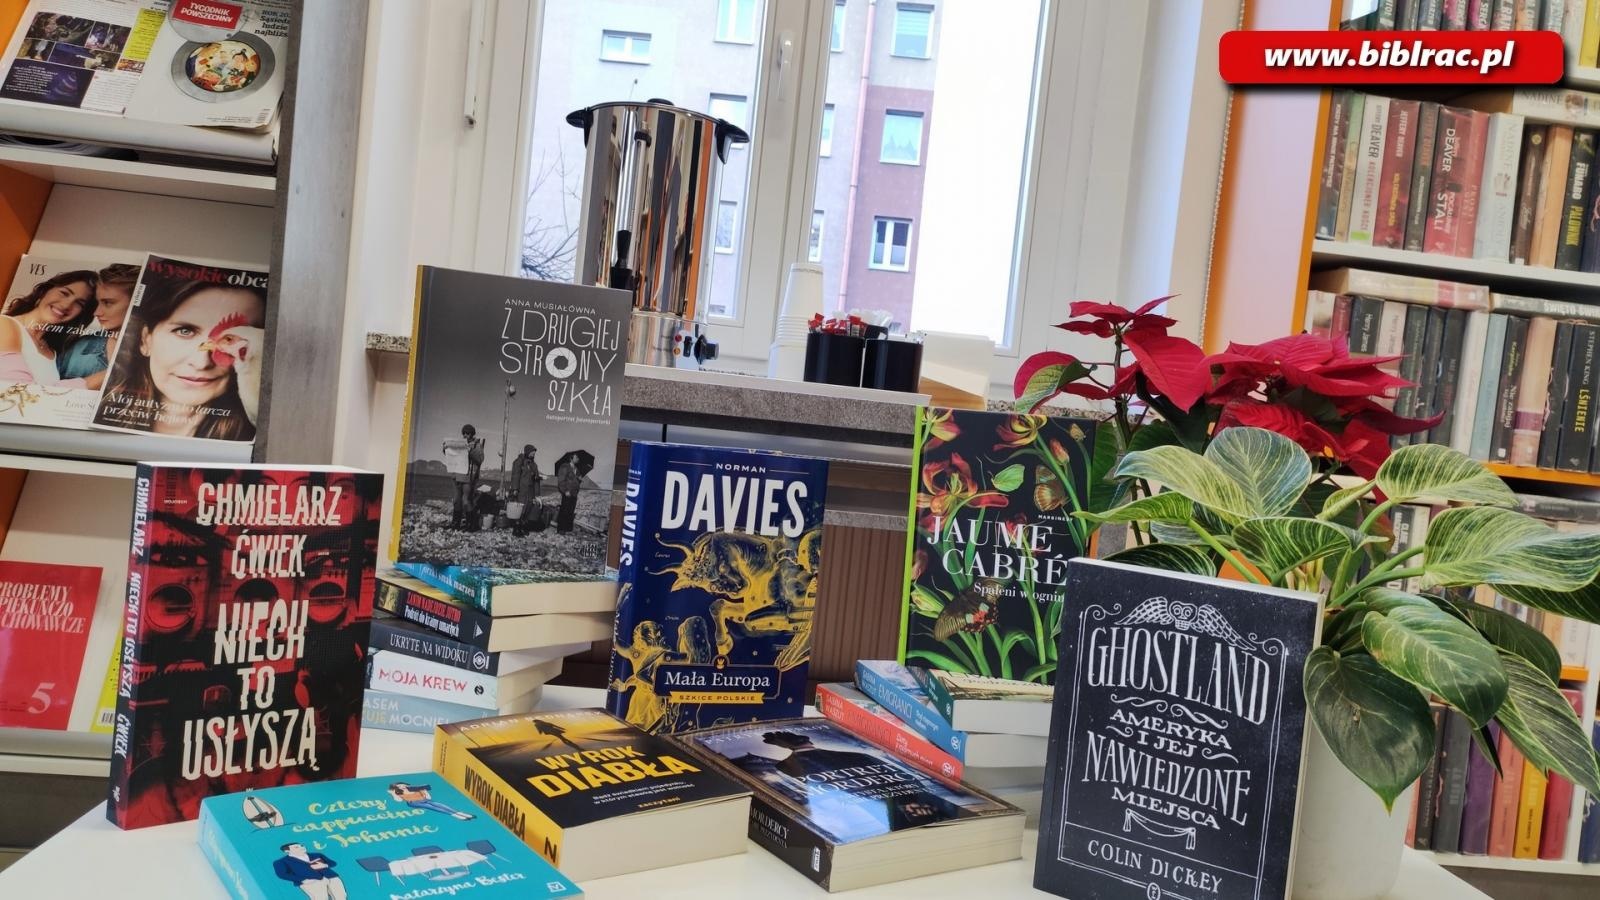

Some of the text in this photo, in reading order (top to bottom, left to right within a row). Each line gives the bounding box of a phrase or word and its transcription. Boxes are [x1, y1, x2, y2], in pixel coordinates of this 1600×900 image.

[180, 7, 234, 23] POWSZECHNY
[190, 2, 231, 15] TYGODNIK
[1367, 124, 1383, 159] DEAVER
[1441, 128, 1456, 172] DEAVER
[28, 263, 48, 276] YES
[148, 261, 227, 283] wysokie
[504, 298, 596, 315] ANNA MUSIAŁÓWNA
[501, 307, 621, 351] Z DRUGIEJ
[499, 341, 617, 383] STRONY
[1582, 330, 1596, 385] STEPHEN KING
[193, 405, 232, 417] tarcza
[547, 380, 611, 417] SZKŁA
[1574, 388, 1591, 433] LŚNIENIE
[715, 462, 767, 475] NORMAN
[130, 476, 151, 557] CHMIELARZ
[196, 482, 343, 527] CHMIELARZ
[660, 469, 809, 539] DAVIES
[620, 481, 641, 568] DAVIES
[927, 514, 1054, 553] JAUME
[230, 529, 308, 580] ĆWIEK
[942, 553, 1069, 587] CABRÉ
[127, 571, 142, 616] NIECH
[973, 582, 1017, 598] Spaleni
[126, 617, 137, 639] TO
[213, 598, 310, 666] NIECH
[390, 633, 469, 665] UKRYTE NA WIDOKU
[236, 665, 277, 712] TO
[378, 669, 469, 694] MOJA KREW
[664, 671, 771, 689] Mała Europa
[1086, 625, 1271, 726] GHOSTLAND
[27, 682, 56, 714] 5
[113, 712, 132, 760] ĆWIEK
[460, 718, 519, 732] ADRIAN
[1110, 708, 1232, 750] AMERYKA
[181, 706, 320, 782] USŁYSZĄ
[535, 745, 647, 772] WYROK
[1137, 730, 1198, 758] I JEJ
[525, 755, 703, 799] DIABŁA
[796, 762, 899, 787] PORTRET
[1081, 731, 1251, 827] NAWIEDZONE
[291, 806, 427, 836] cappuccino
[308, 798, 388, 817] Cztery
[463, 764, 526, 844] WYROK DIABŁA
[1111, 787, 1221, 830] MIEJSCA
[312, 822, 440, 851] i Johnnie
[475, 872, 527, 886] Bester
[1087, 839, 1222, 894] COLIN DICKEY
